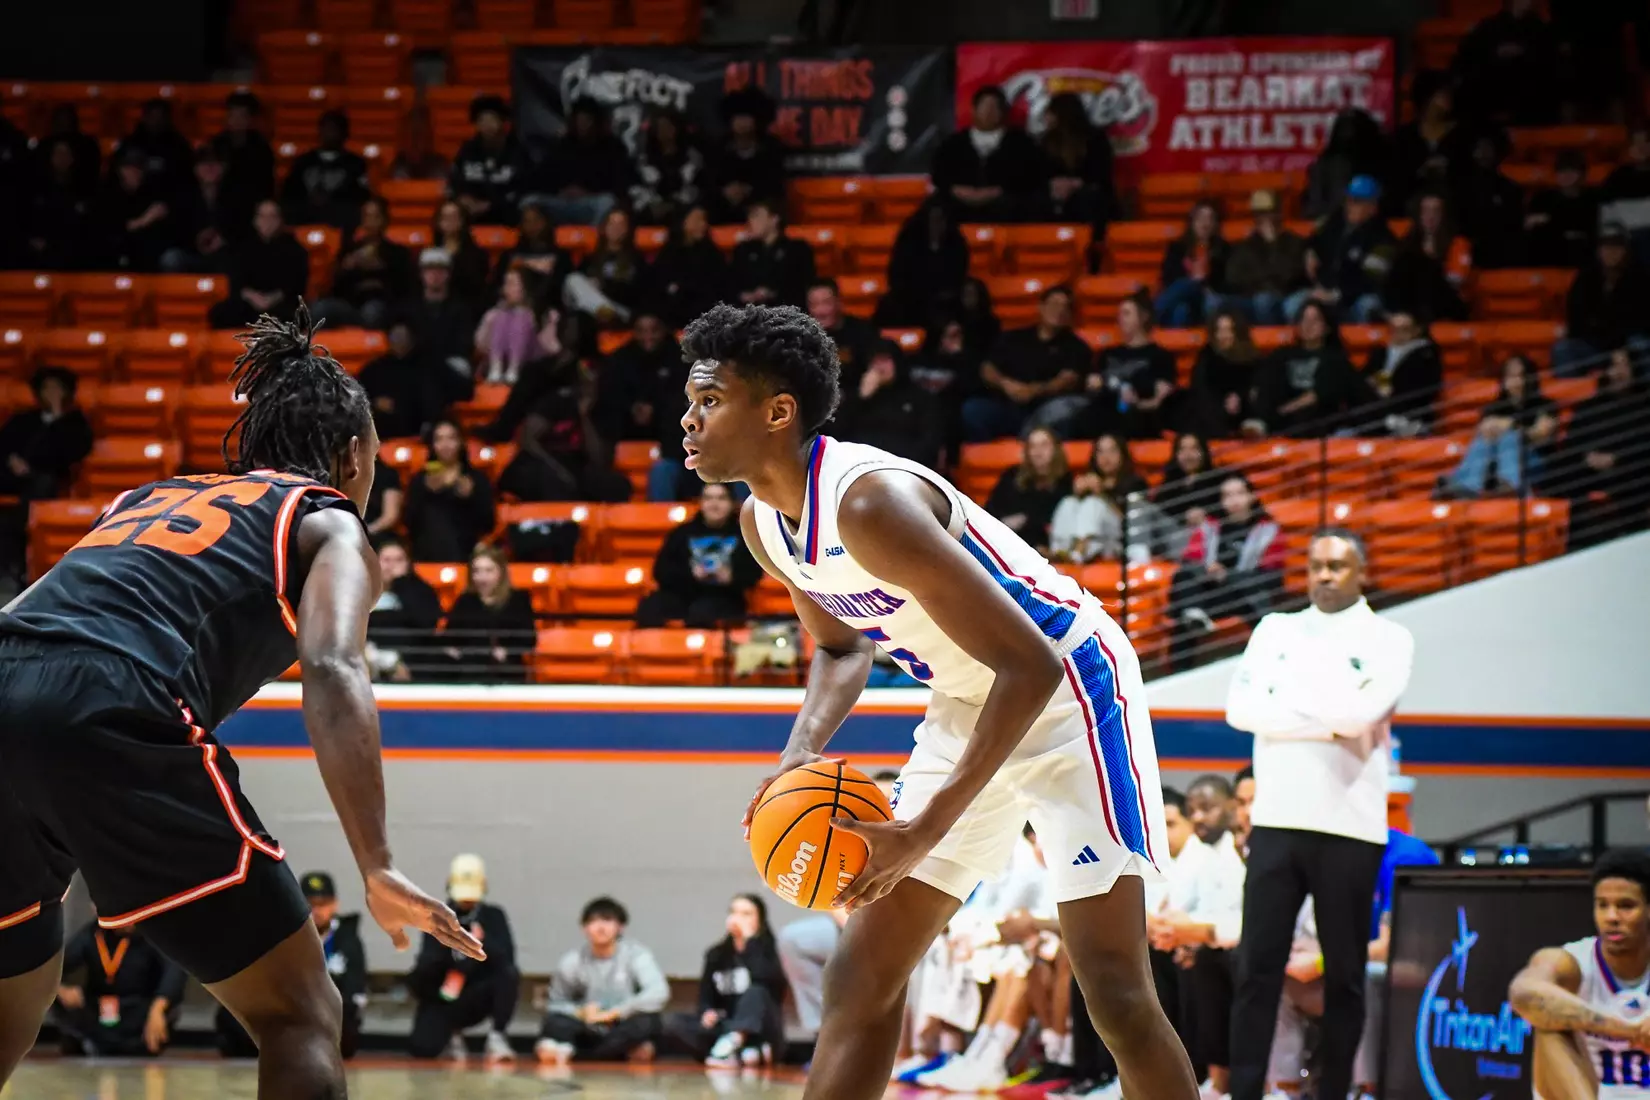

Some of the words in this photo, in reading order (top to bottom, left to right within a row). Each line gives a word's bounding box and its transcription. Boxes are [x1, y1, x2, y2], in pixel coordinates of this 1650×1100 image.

[778, 58, 875, 100] THINGS
[1185, 74, 1372, 111] BEARKAT
[64, 481, 271, 556] 25
